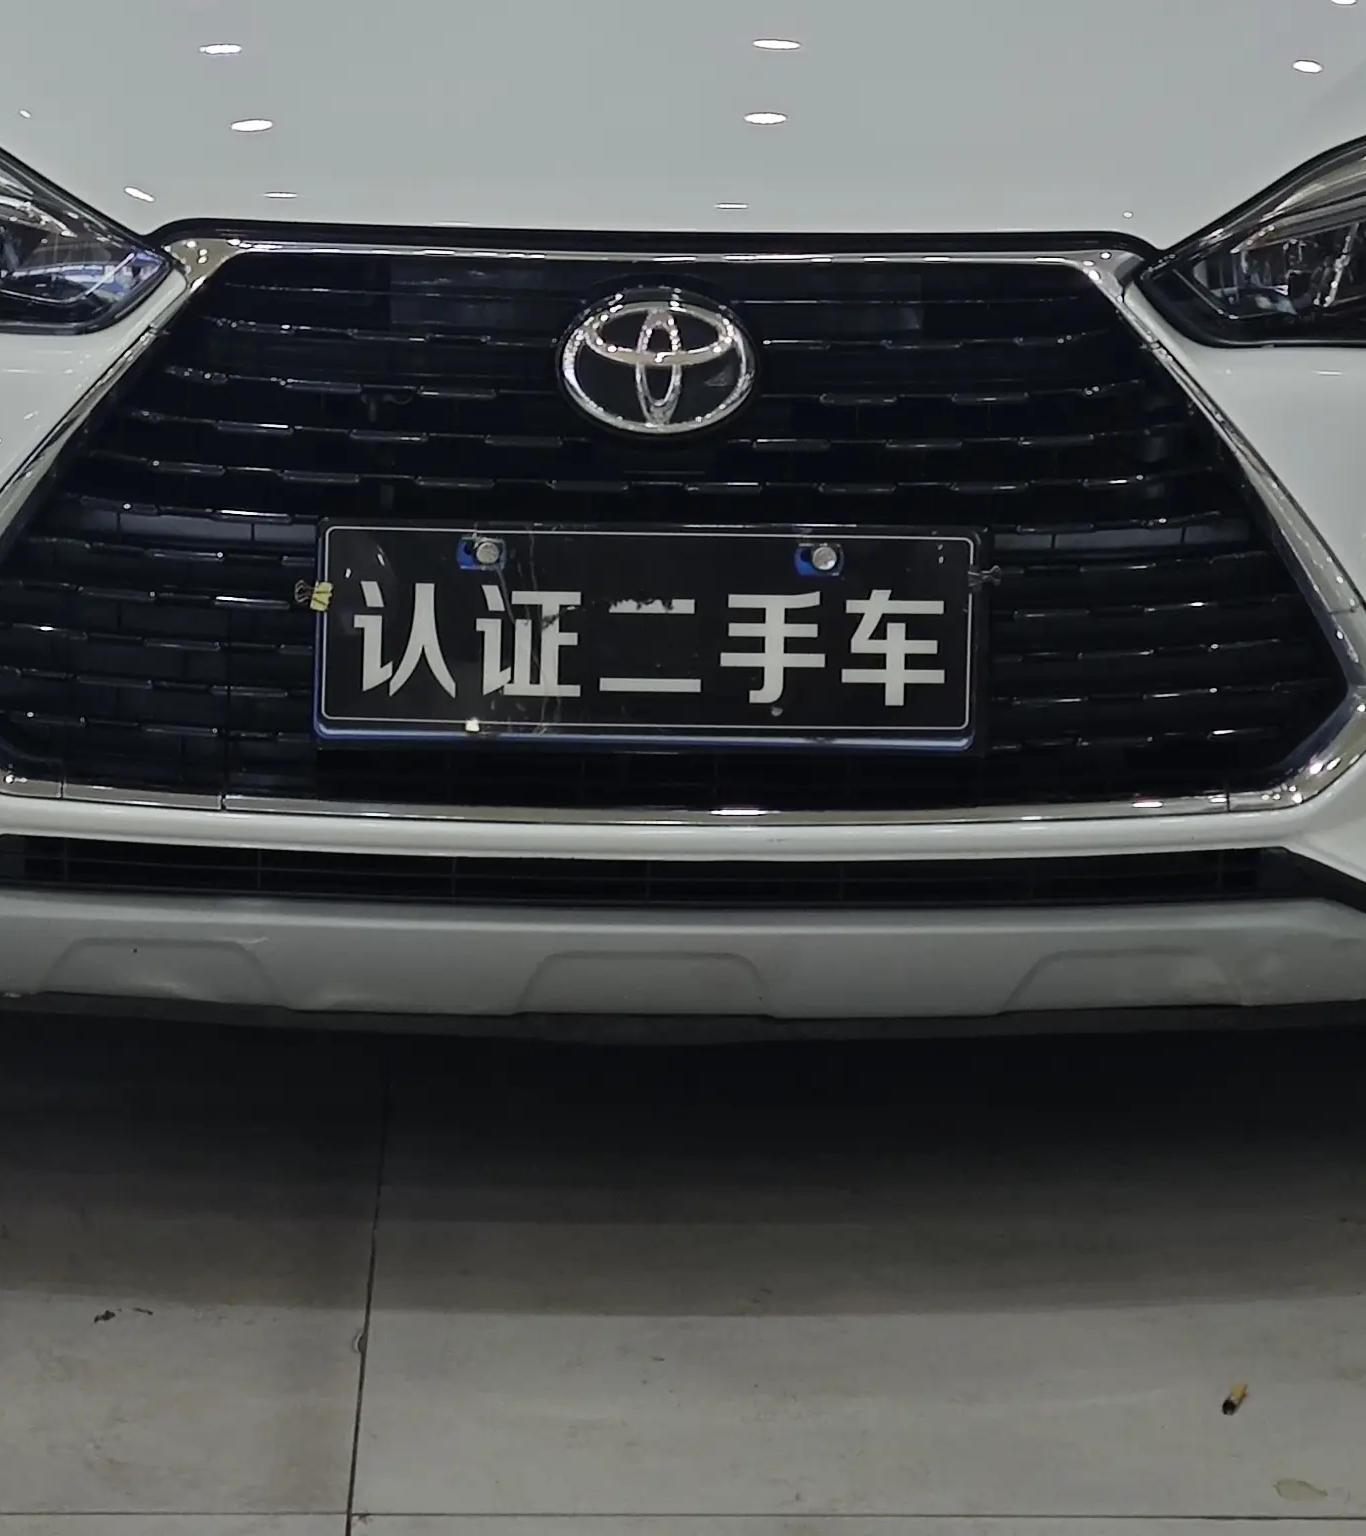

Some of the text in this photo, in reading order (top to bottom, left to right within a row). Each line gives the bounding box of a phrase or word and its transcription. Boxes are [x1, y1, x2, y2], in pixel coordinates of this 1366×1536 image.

[353, 580, 946, 707] 认证二手车
